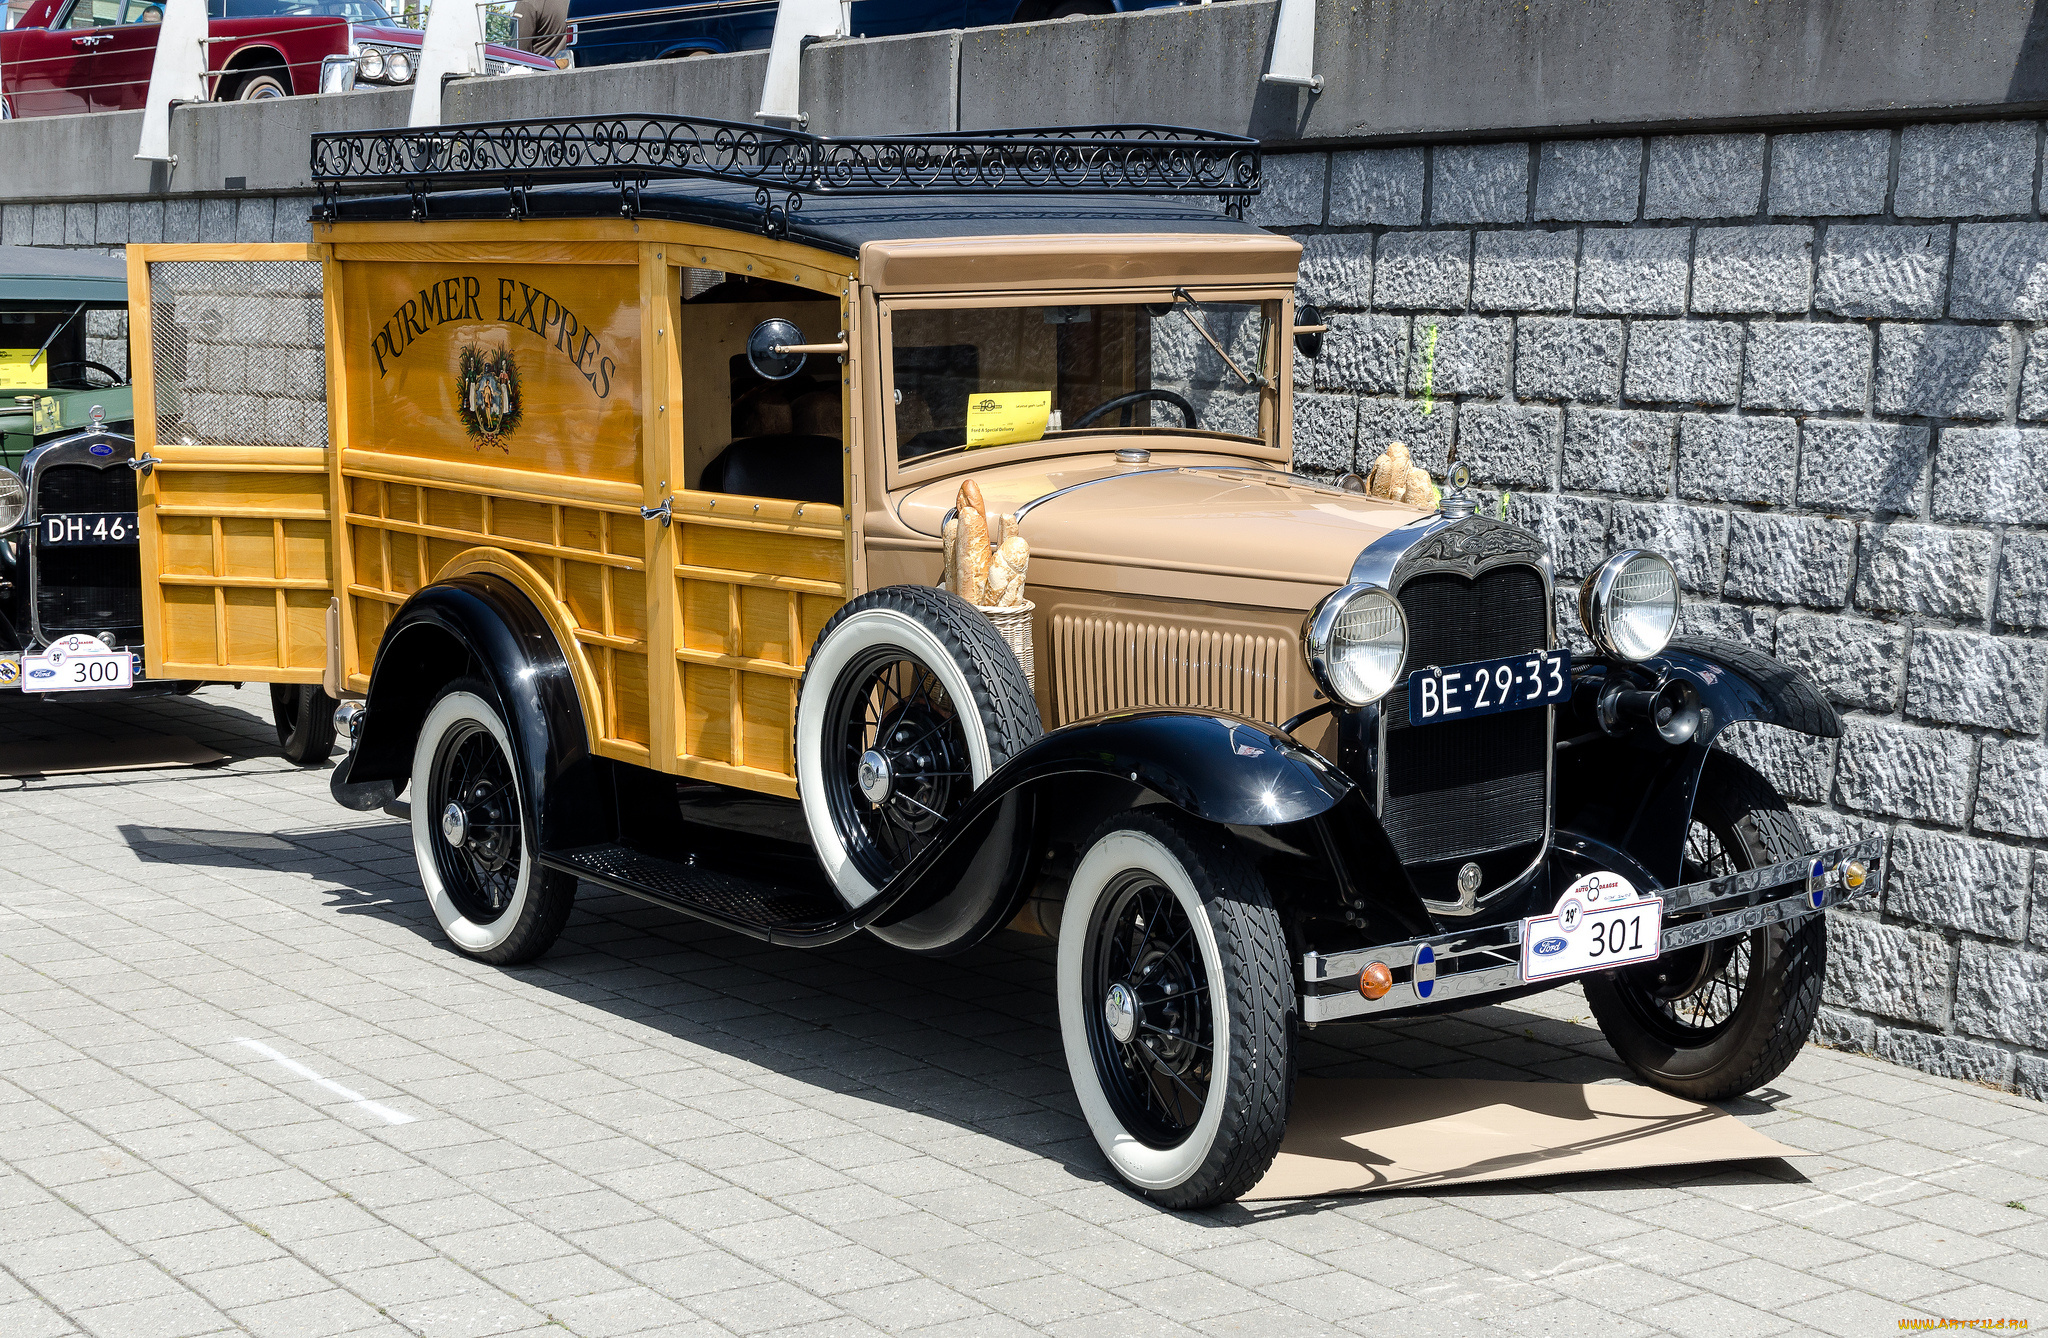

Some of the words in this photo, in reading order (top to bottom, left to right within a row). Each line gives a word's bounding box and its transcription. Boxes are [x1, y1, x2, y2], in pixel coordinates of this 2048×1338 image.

[372, 276, 483, 379] PURMER
[497, 277, 616, 399] EXPRES
[49, 517, 139, 542] DH-46-
[74, 661, 118, 683] 300
[1421, 657, 1563, 718] BE-29-33
[1587, 877, 1600, 902] 8
[1589, 915, 1642, 957] 301
